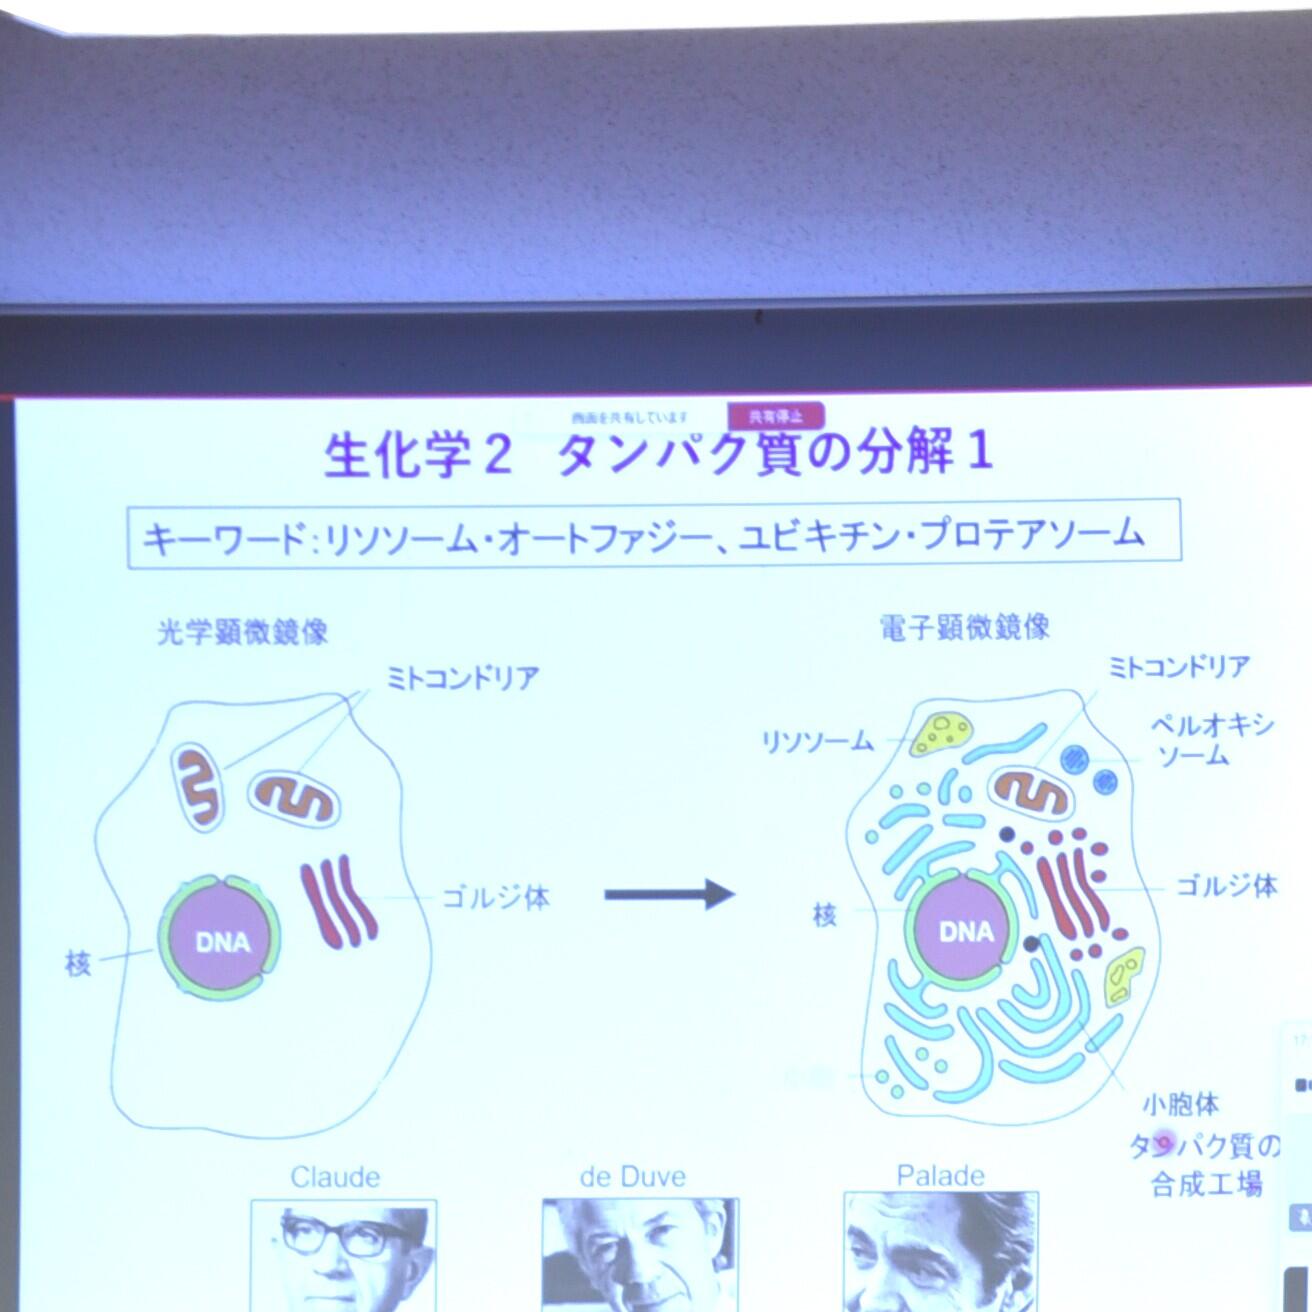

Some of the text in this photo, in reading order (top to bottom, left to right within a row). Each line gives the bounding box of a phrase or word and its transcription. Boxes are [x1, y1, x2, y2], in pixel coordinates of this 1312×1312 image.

[324, 429, 512, 479] 生化学2
[157, 617, 328, 647] 光学顕微鏡像
[879, 611, 1050, 643] 電子顕微鏡像
[388, 663, 540, 692] ミトコンドリア
[1110, 653, 1251, 680] ミトコンドリア
[1151, 712, 1275, 739] ペルオキシ
[763, 728, 875, 755] リソソーム
[1159, 743, 1231, 769] ソーム
[443, 883, 551, 912] ゴルジ体
[1177, 872, 1278, 899] ゴルジ体
[812, 901, 837, 928] 核
[196, 931, 252, 953] DNA
[939, 919, 995, 943] DNA
[64, 949, 92, 978] 核
[1142, 1090, 1220, 1117] 小胞体
[290, 1164, 381, 1189] Claude
[579, 1164, 687, 1188] de Duve
[897, 1163, 986, 1187] Palade
[1150, 1168, 1264, 1198] 合成工場
